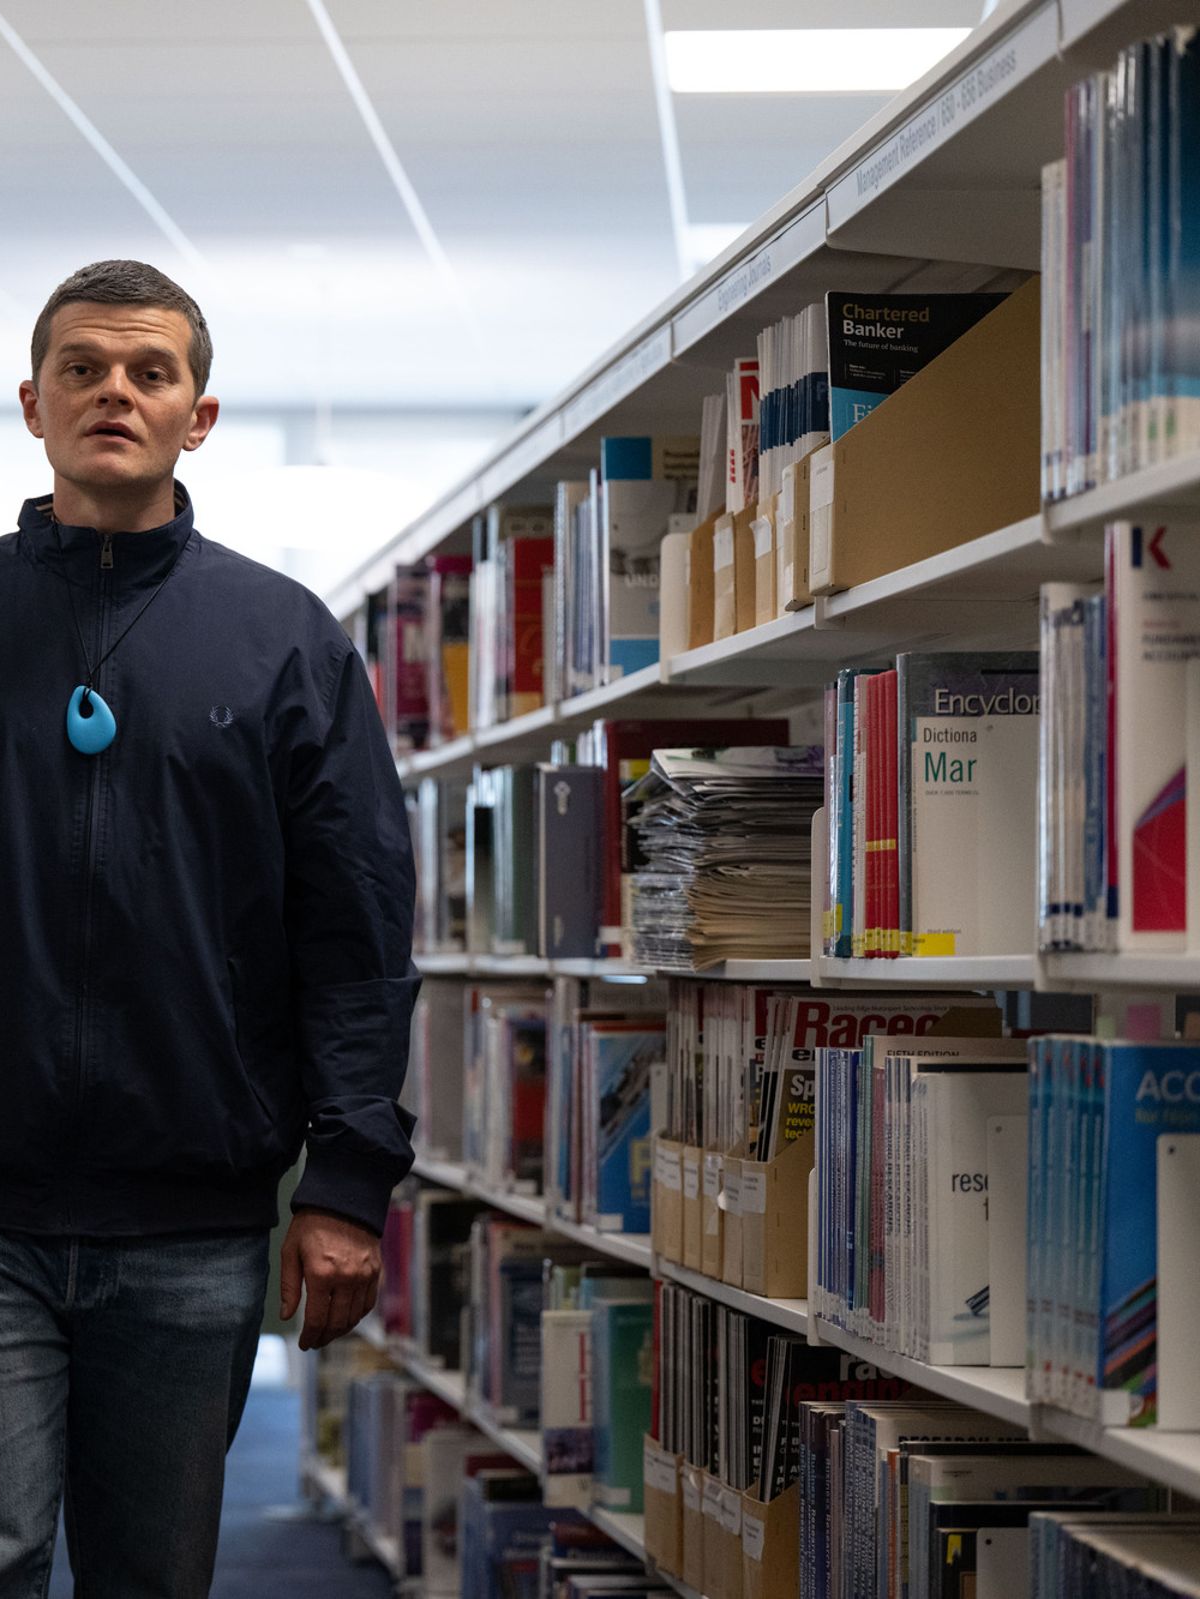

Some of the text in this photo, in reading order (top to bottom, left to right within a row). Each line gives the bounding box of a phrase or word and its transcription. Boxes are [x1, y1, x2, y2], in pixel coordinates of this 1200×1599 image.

[842, 303, 930, 323] Chartered
[843, 320, 904, 338] Banker
[844, 339, 919, 353] The future of banking
[923, 727, 977, 743] Dictiona
[924, 751, 977, 782] Mar
